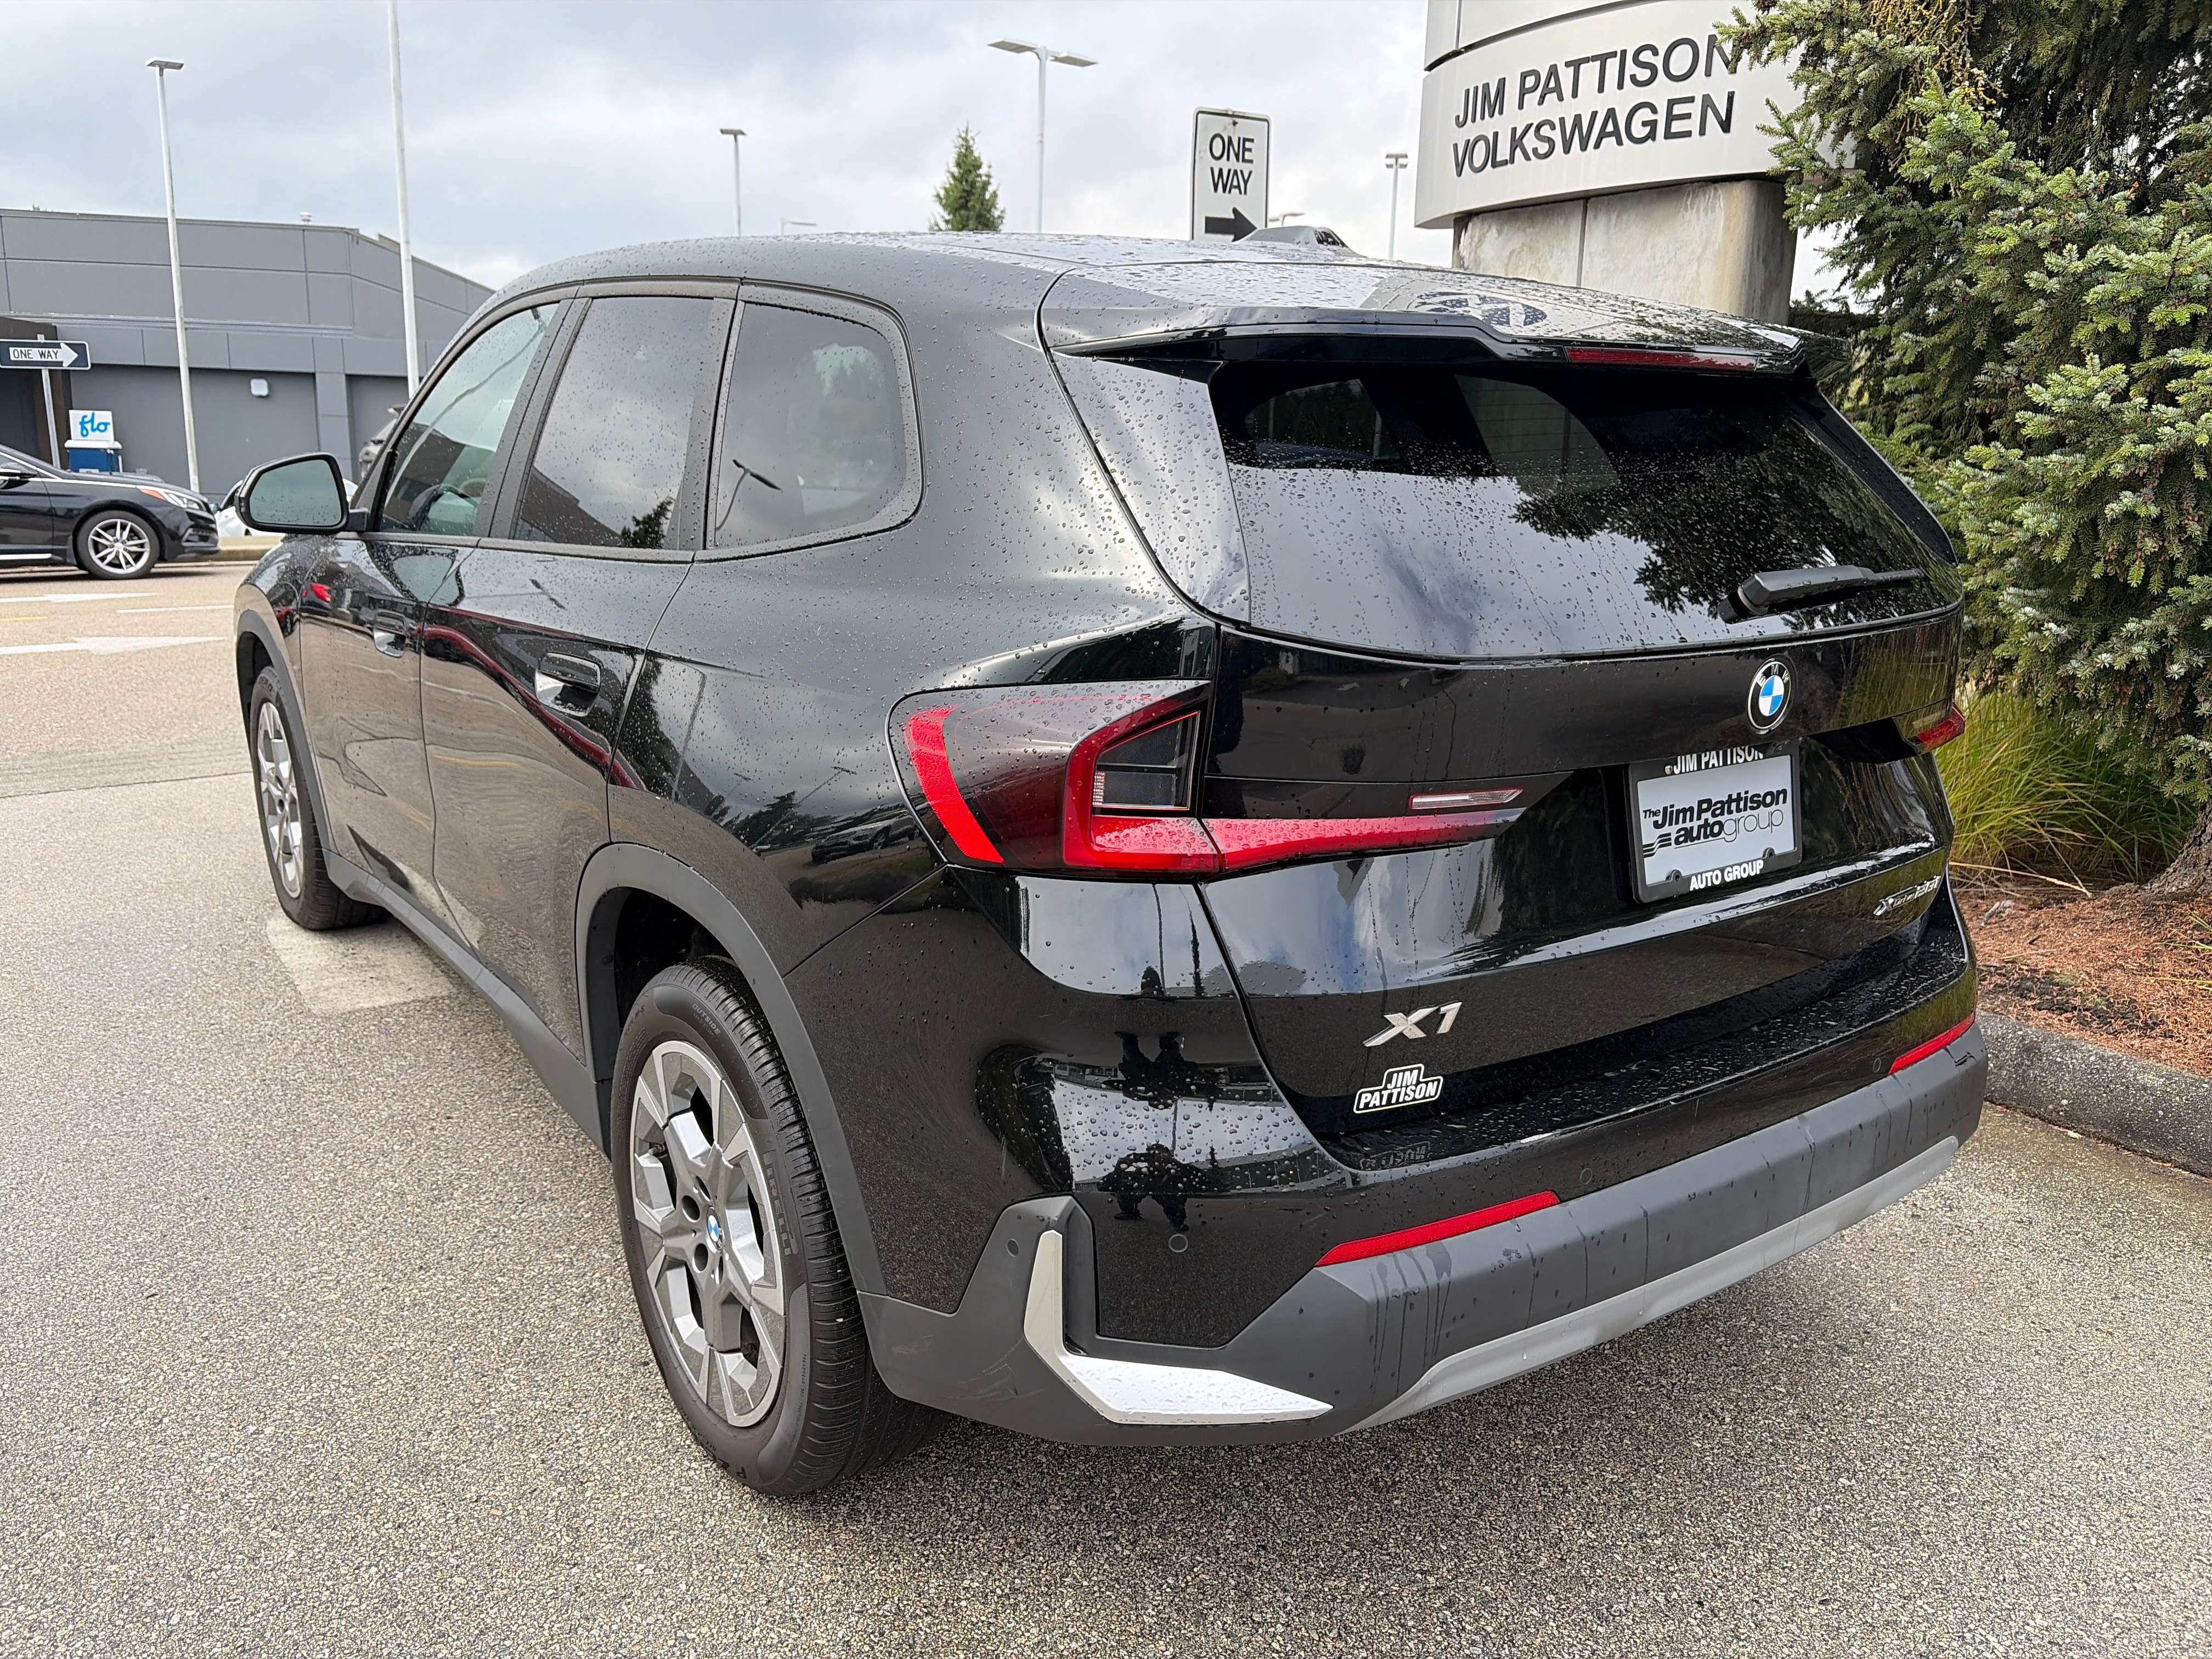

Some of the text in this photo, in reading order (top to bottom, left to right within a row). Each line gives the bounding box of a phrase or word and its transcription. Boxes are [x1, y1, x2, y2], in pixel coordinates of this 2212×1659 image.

[1455, 33, 1738, 128] JIM PATTISON
[1209, 133, 1255, 165] ONE
[1453, 91, 1736, 178] VOLKSWAGEN
[1209, 167, 1254, 196] WAY
[13, 349, 59, 360] ONE WAY
[79, 411, 111, 437] flo
[1756, 664, 1790, 687] BMW
[1673, 753, 1697, 775] JIM
[1643, 788, 1787, 830] The Jim Pattison
[1690, 860, 1764, 891] AUTO GROUP
[692, 1003, 721, 1035] OUTSIDE
[1363, 1001, 1463, 1047] X1
[1387, 1069, 1419, 1089] JIM
[1359, 1081, 1438, 1109] PATTISON
